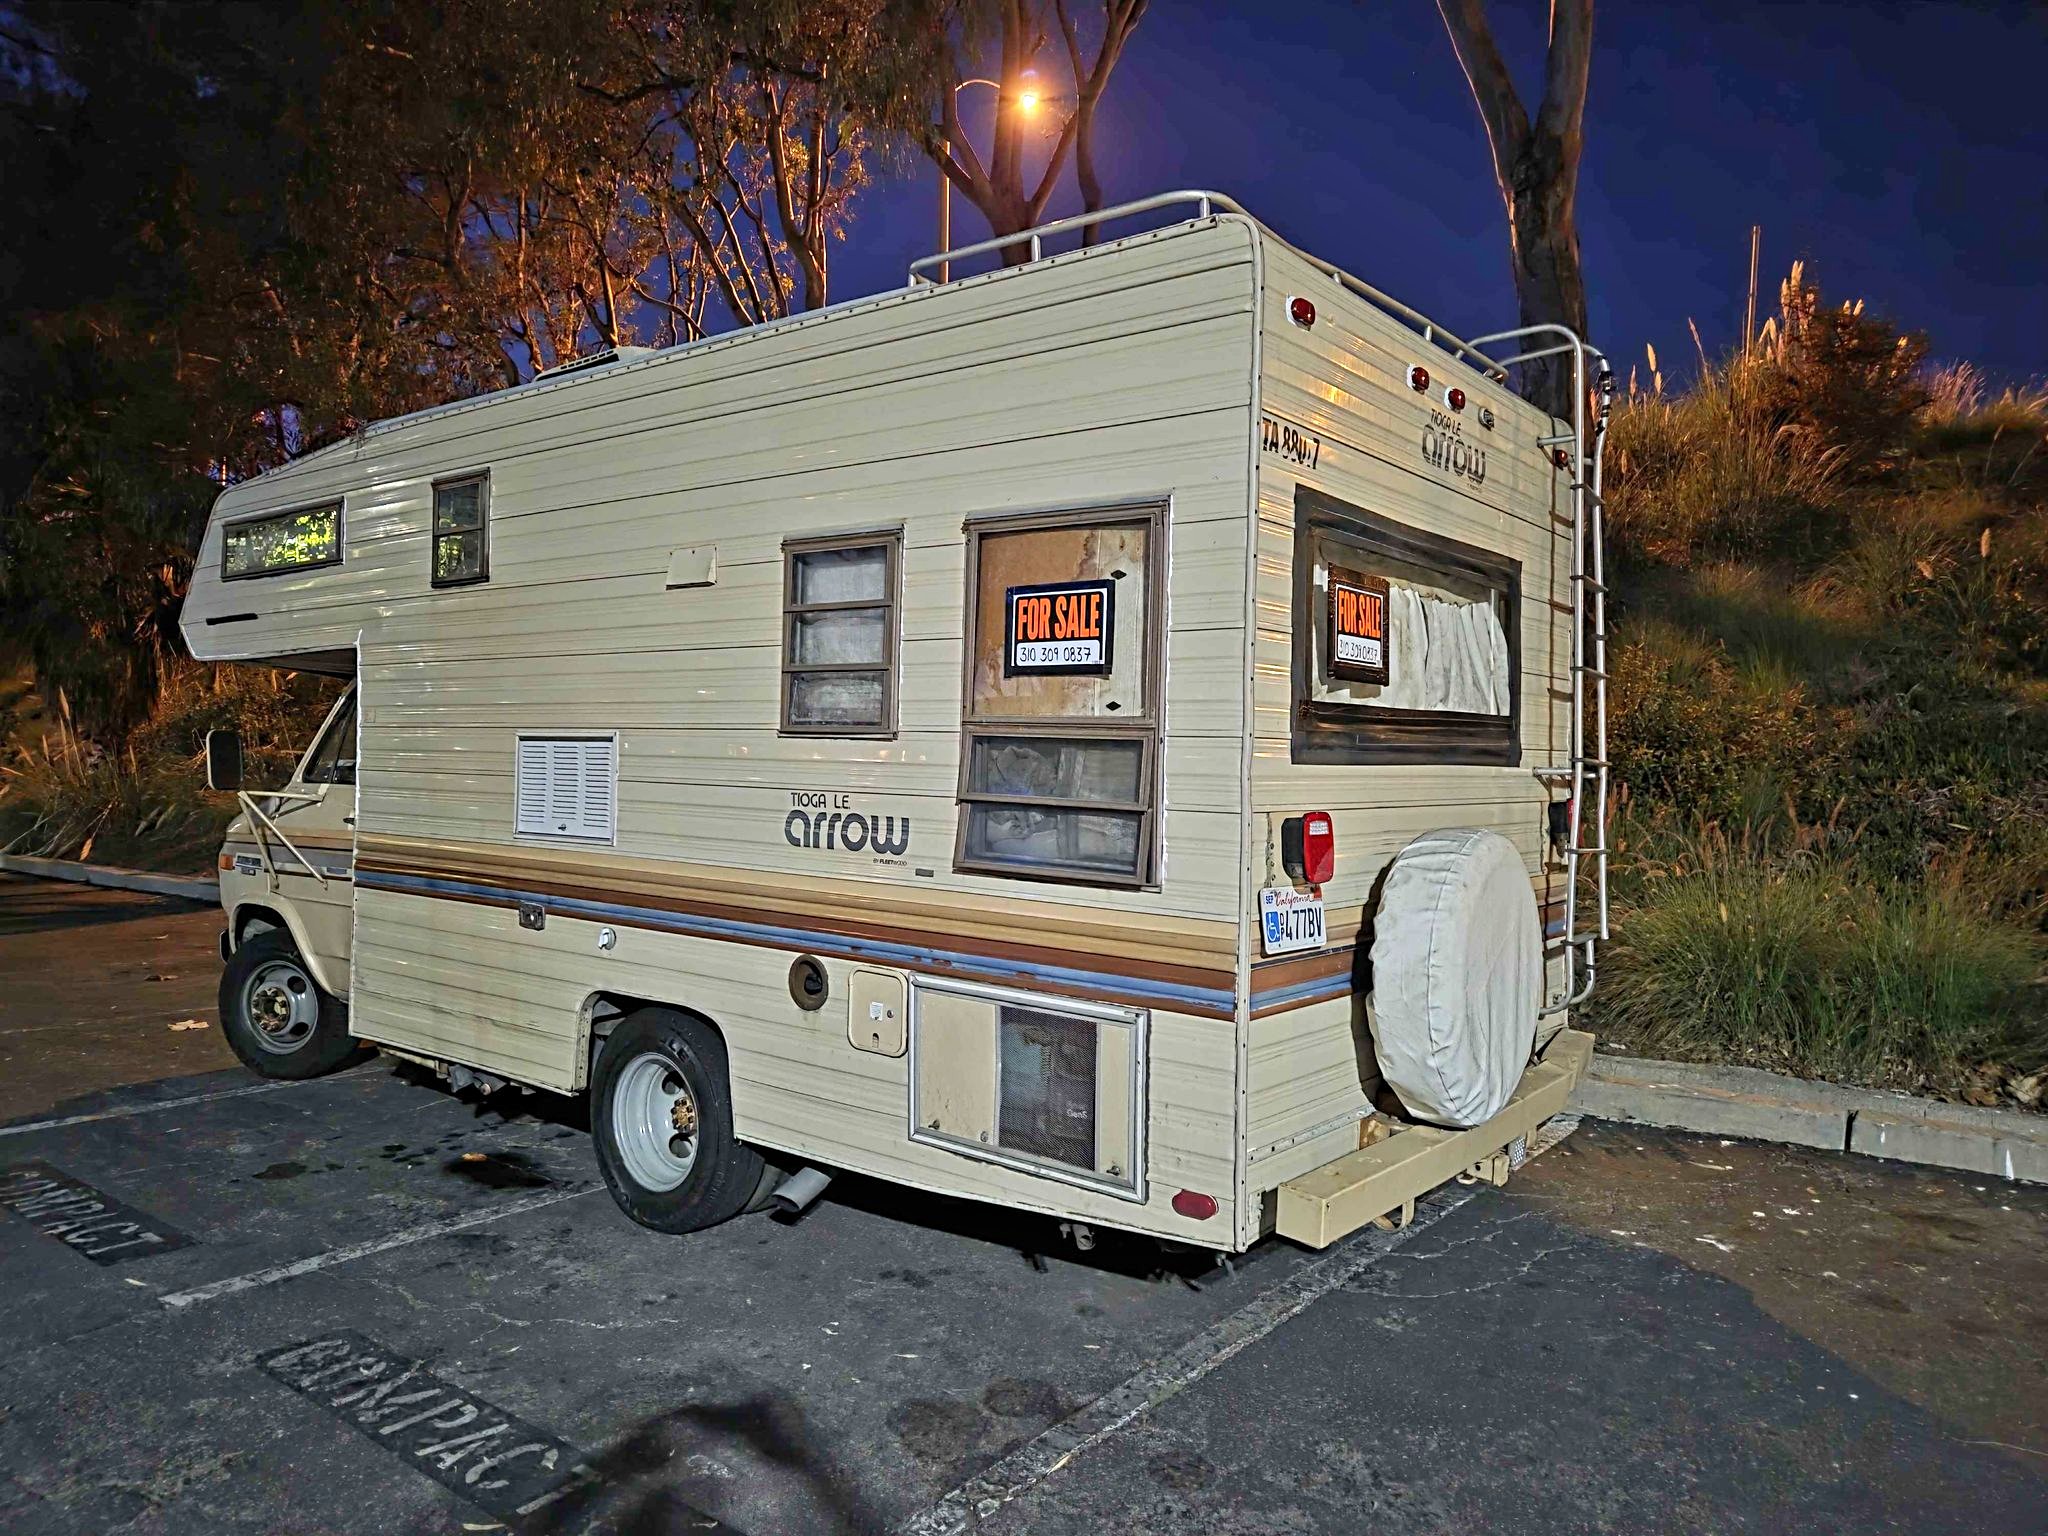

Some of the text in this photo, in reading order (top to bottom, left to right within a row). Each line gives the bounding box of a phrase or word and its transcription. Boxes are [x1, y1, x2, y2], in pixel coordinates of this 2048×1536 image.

[1262, 416, 1279, 453] TA
[1431, 408, 1451, 432] TIOGA
[1017, 594, 1100, 640] FOR SALE
[1337, 590, 1381, 639] FOR SALE
[1019, 646, 1092, 662] 310 309 0837
[790, 792, 827, 809] TIOGA
[784, 809, 910, 856] arrow
[1274, 889, 1315, 909] California
[1285, 907, 1322, 941] 477BV
